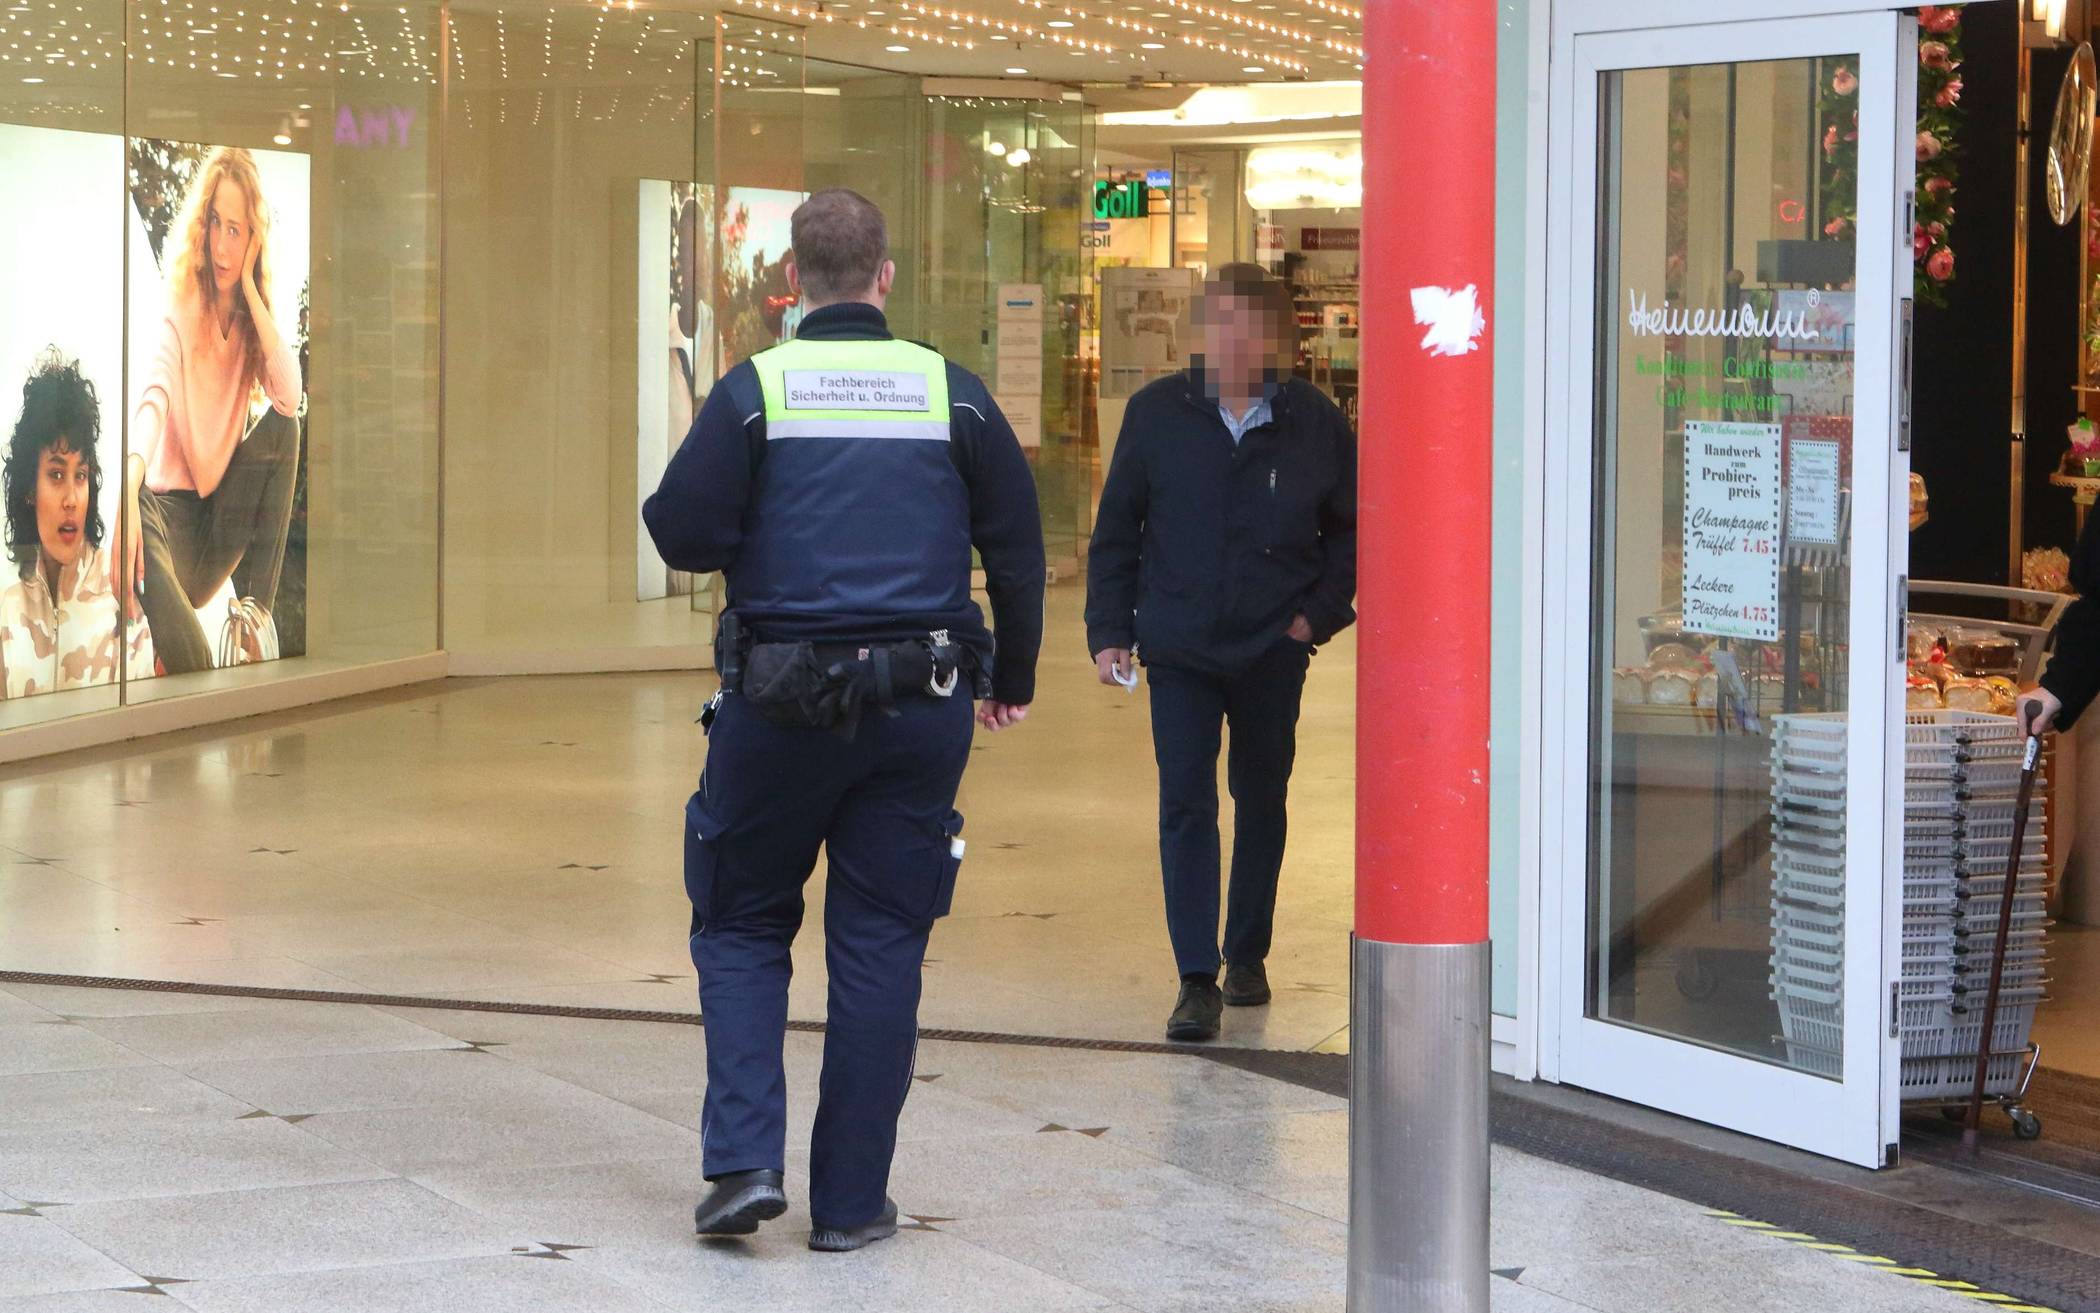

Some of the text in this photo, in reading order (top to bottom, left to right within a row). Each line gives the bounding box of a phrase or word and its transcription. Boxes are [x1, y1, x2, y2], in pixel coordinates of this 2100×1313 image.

[1091, 180, 1140, 219] Goll
[1080, 234, 1111, 248] Goll
[819, 376, 896, 389] Fachbereich
[791, 390, 925, 405] Sicherheit u. Ordnung
[1704, 443, 1762, 459] Handwerk
[1730, 461, 1747, 469] zum
[1702, 467, 1758, 484] Probier-
[1728, 484, 1761, 501] preis
[1691, 507, 1769, 535] Champagne
[1692, 531, 1737, 556] Trüffel
[1690, 574, 1735, 593] Leckere
[1692, 599, 1739, 620] Plätzchen
